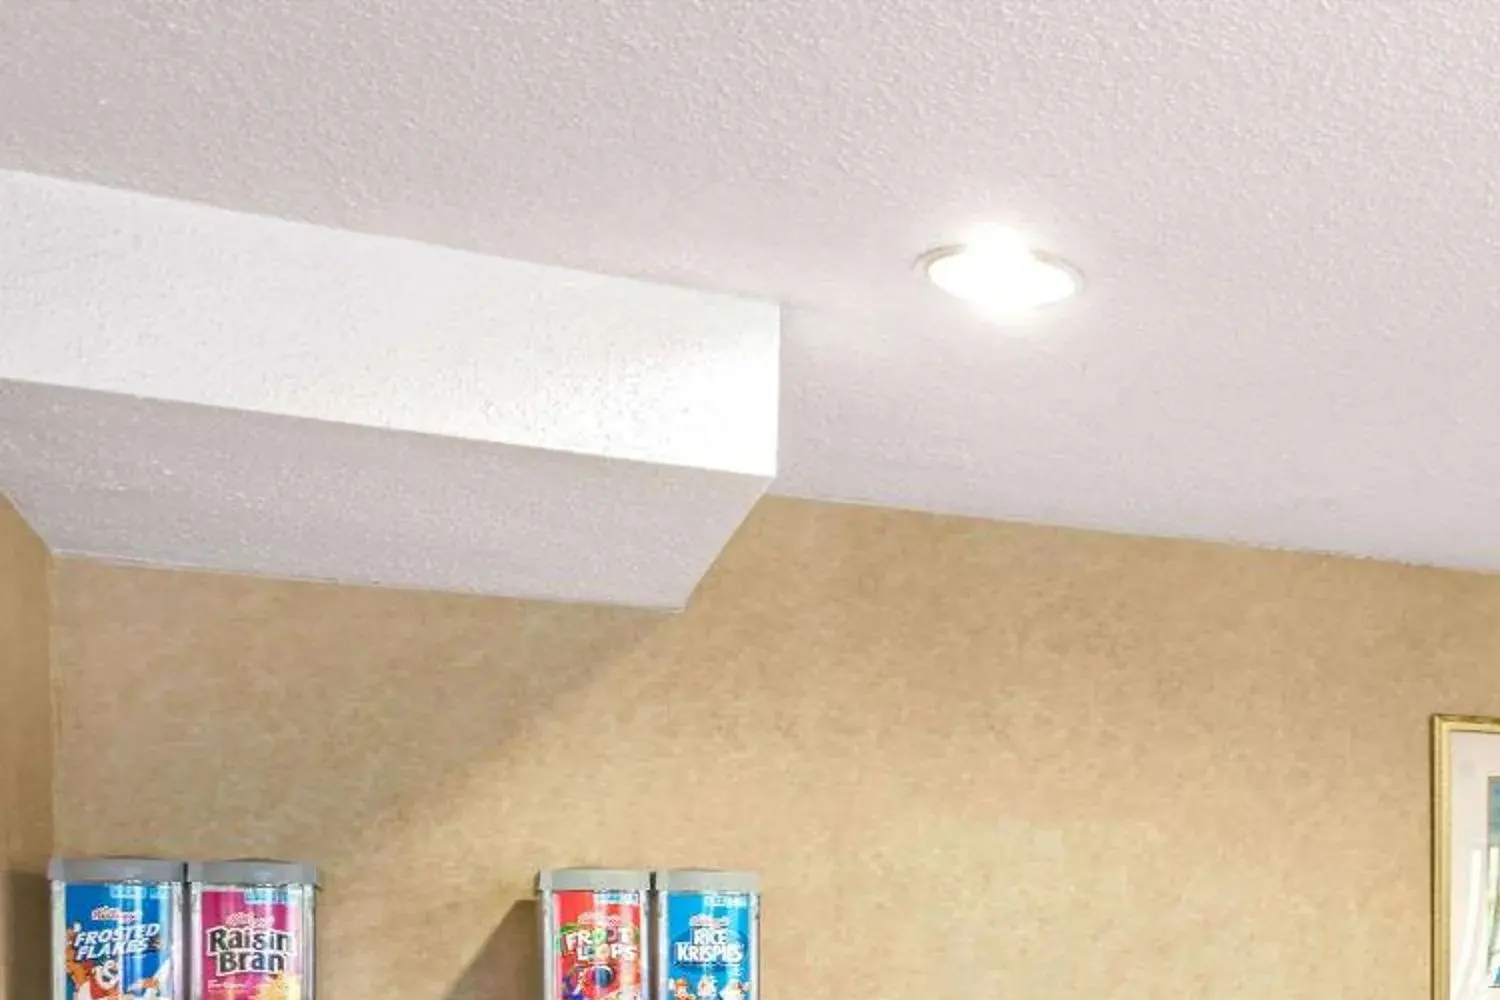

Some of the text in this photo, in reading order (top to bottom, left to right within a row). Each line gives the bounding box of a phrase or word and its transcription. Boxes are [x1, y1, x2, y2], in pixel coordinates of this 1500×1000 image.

[74, 922, 160, 948] FROSTED
[208, 927, 295, 953] Raisin
[693, 927, 729, 946] RICE
[76, 937, 149, 961] FLAKES
[219, 951, 285, 973] Bran
